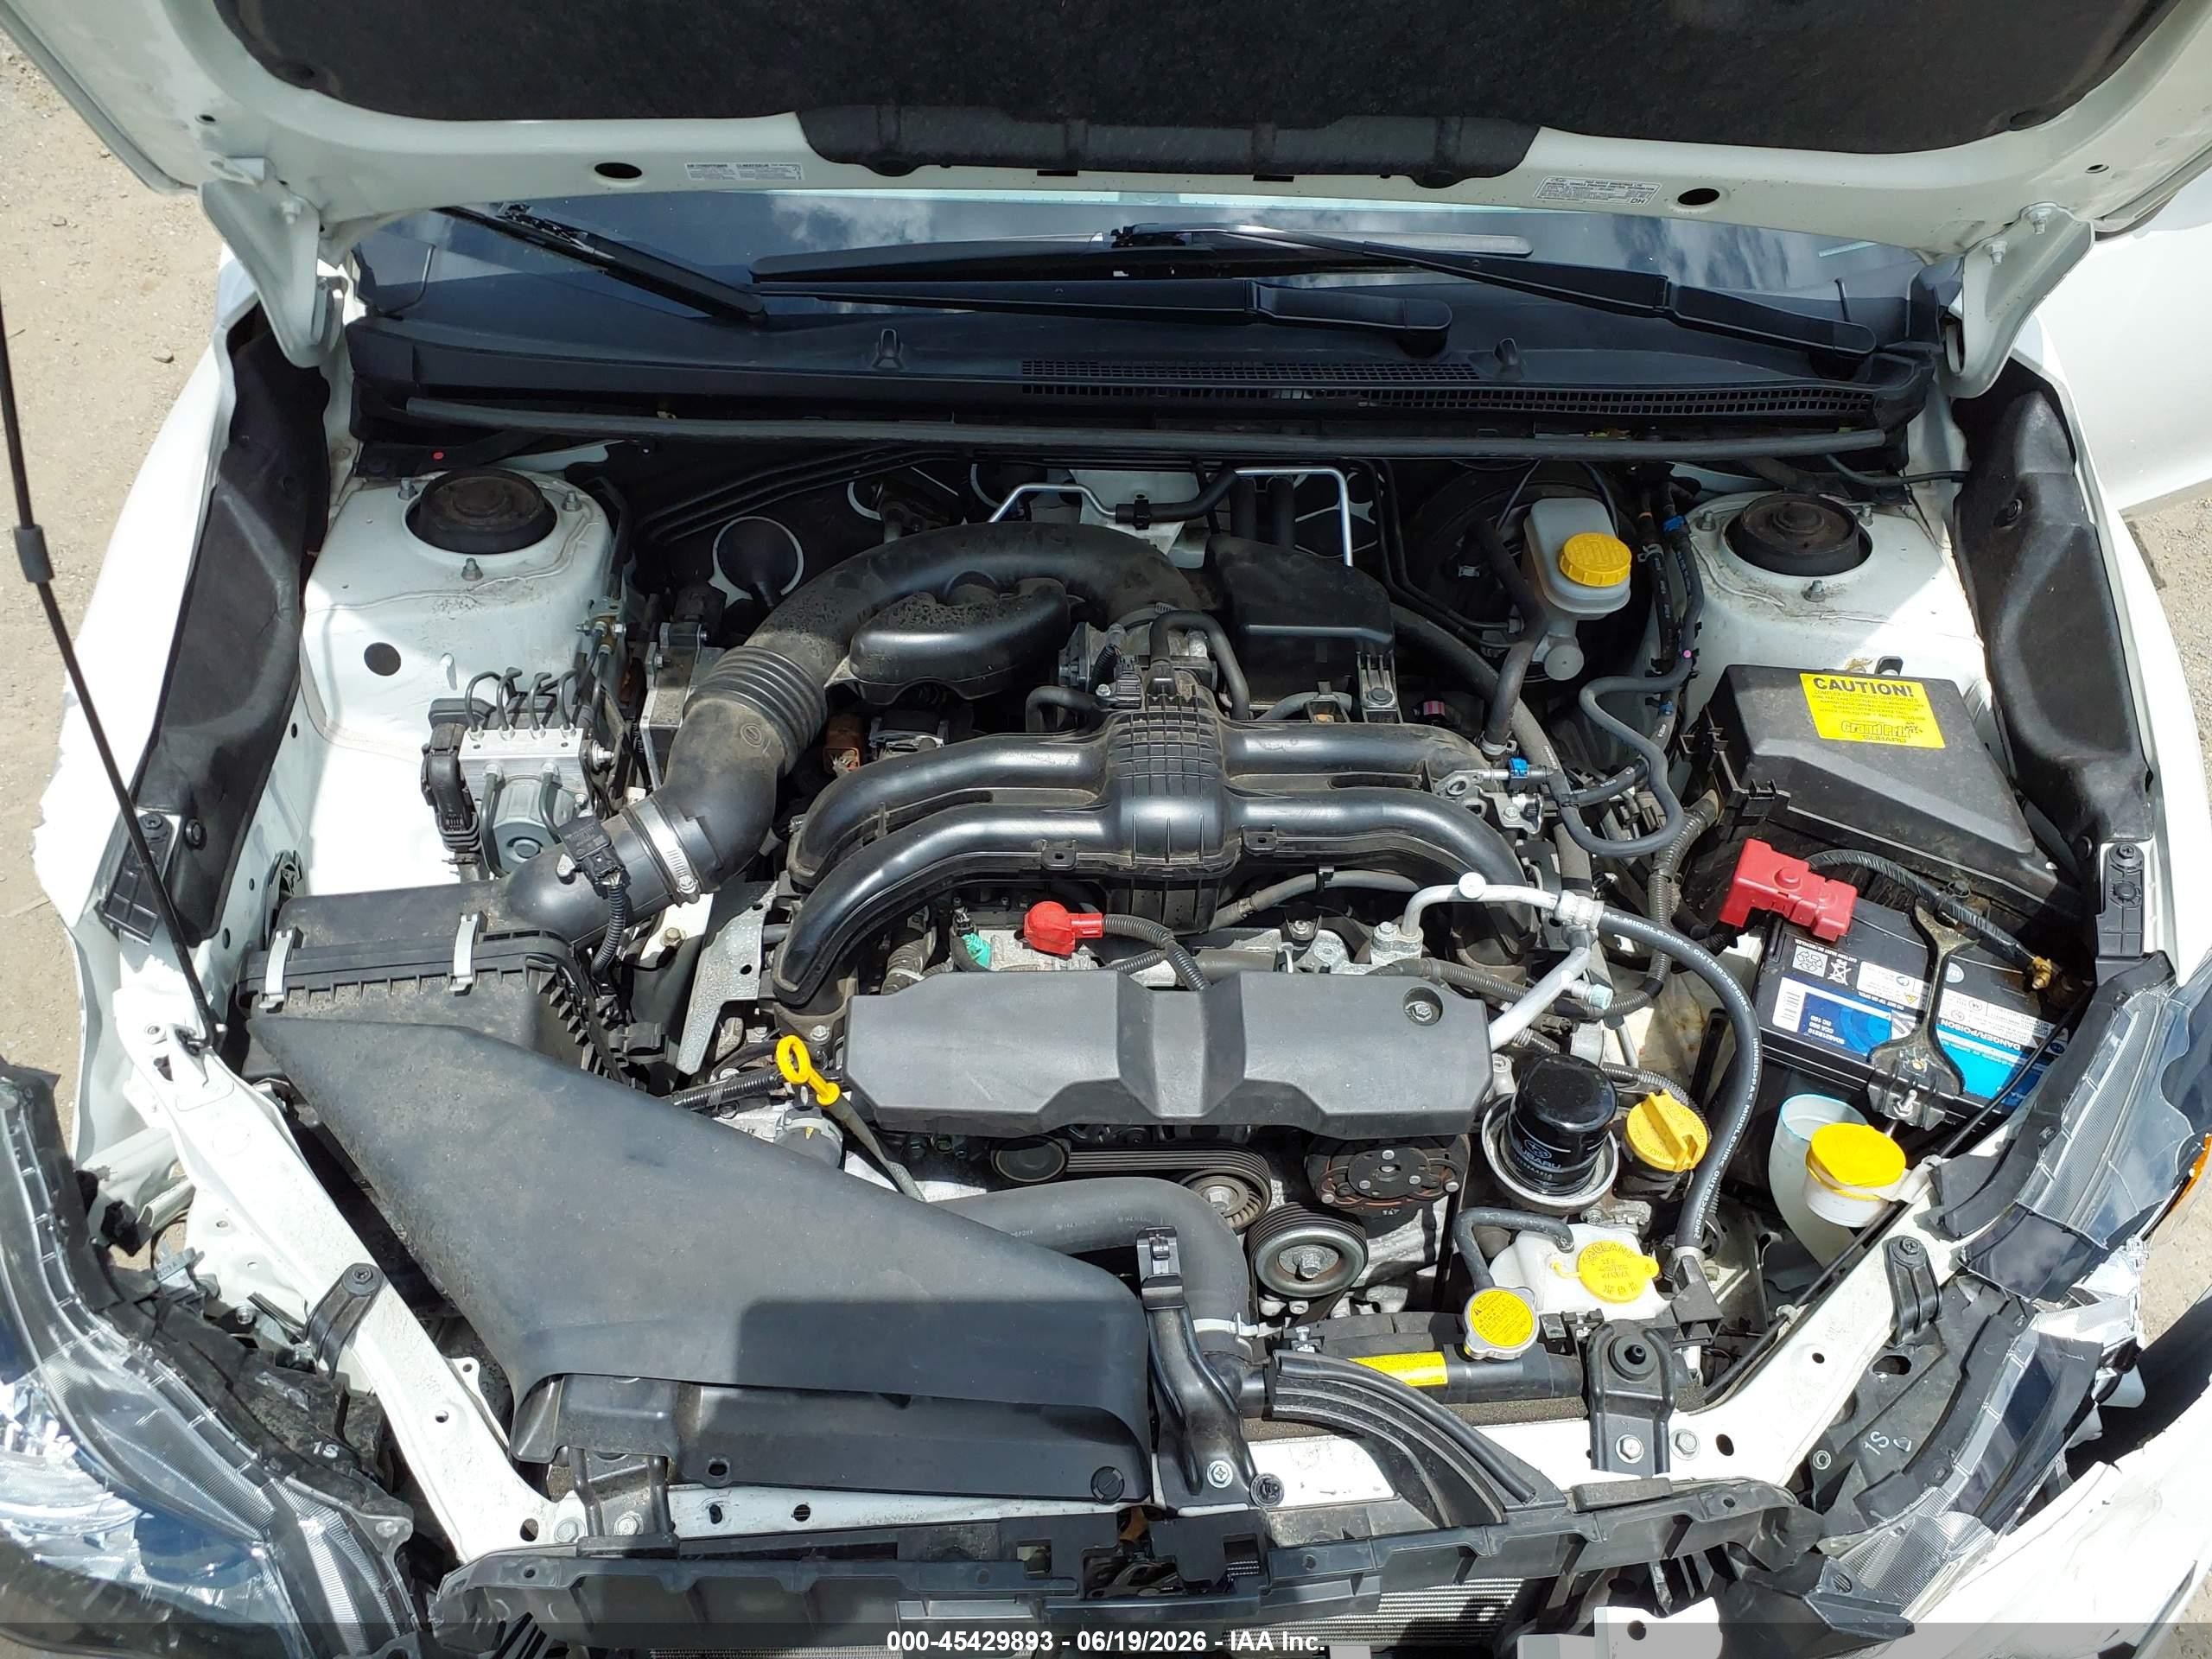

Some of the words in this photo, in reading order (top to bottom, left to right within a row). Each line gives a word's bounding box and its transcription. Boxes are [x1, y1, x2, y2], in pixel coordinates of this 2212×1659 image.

[1813, 677, 1914, 697] CAUTION!
[1841, 721, 1883, 735] Grand
[1941, 1019, 2021, 1051] DANGER/POISON
[313, 1440, 340, 1459] 1S
[1864, 1431, 1890, 1456] 1S
